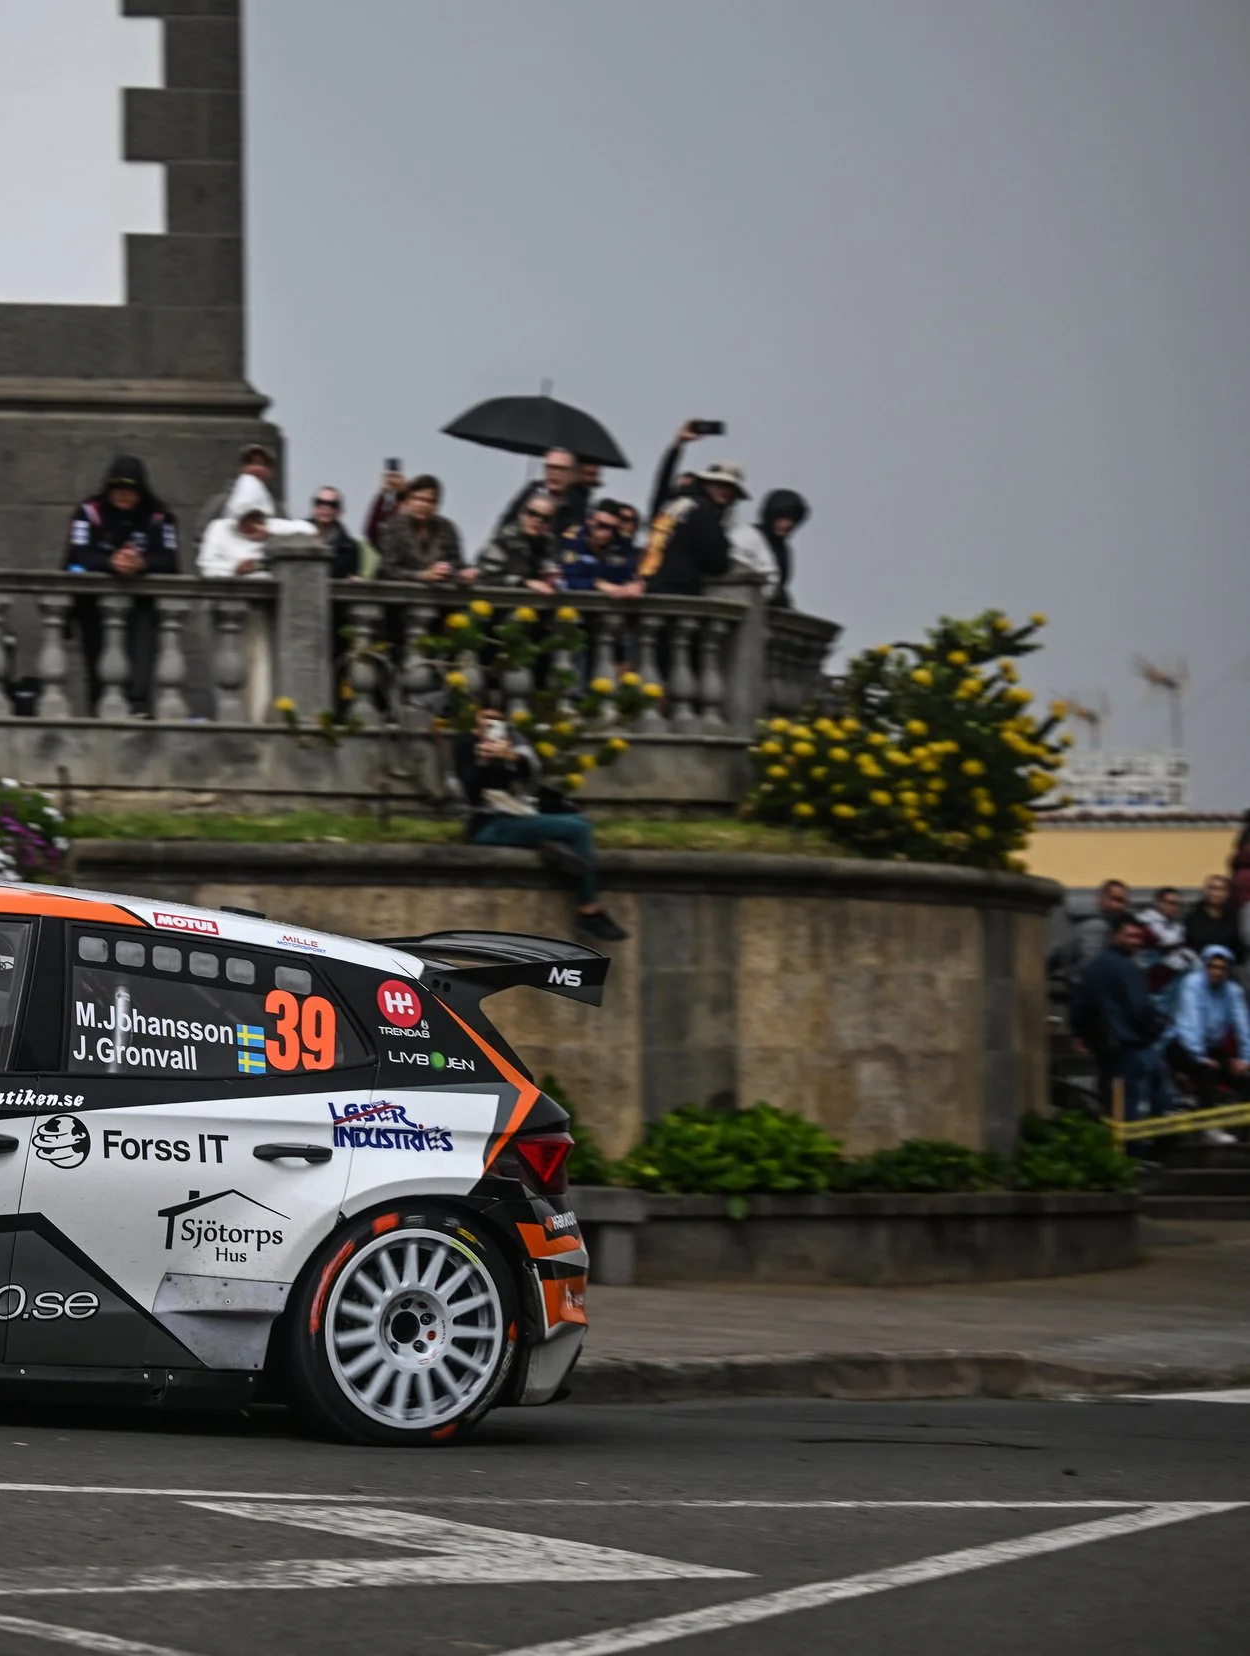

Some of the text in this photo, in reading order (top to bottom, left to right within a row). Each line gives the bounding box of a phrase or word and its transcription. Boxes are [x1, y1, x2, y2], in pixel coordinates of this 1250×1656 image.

[155, 913, 217, 933] MOTUL
[282, 935, 319, 948] MILLE
[548, 966, 582, 987] MS
[75, 1001, 234, 1045] M.Johansson
[264, 989, 336, 1072] 39
[378, 1026, 430, 1039] TRENDAB
[328, 1100, 418, 1128] LASER
[103, 1129, 230, 1164] Forss IT
[333, 1126, 454, 1152] INDUSTRIES
[181, 1218, 284, 1252] Sjötorps
[215, 1247, 248, 1263] Hus
